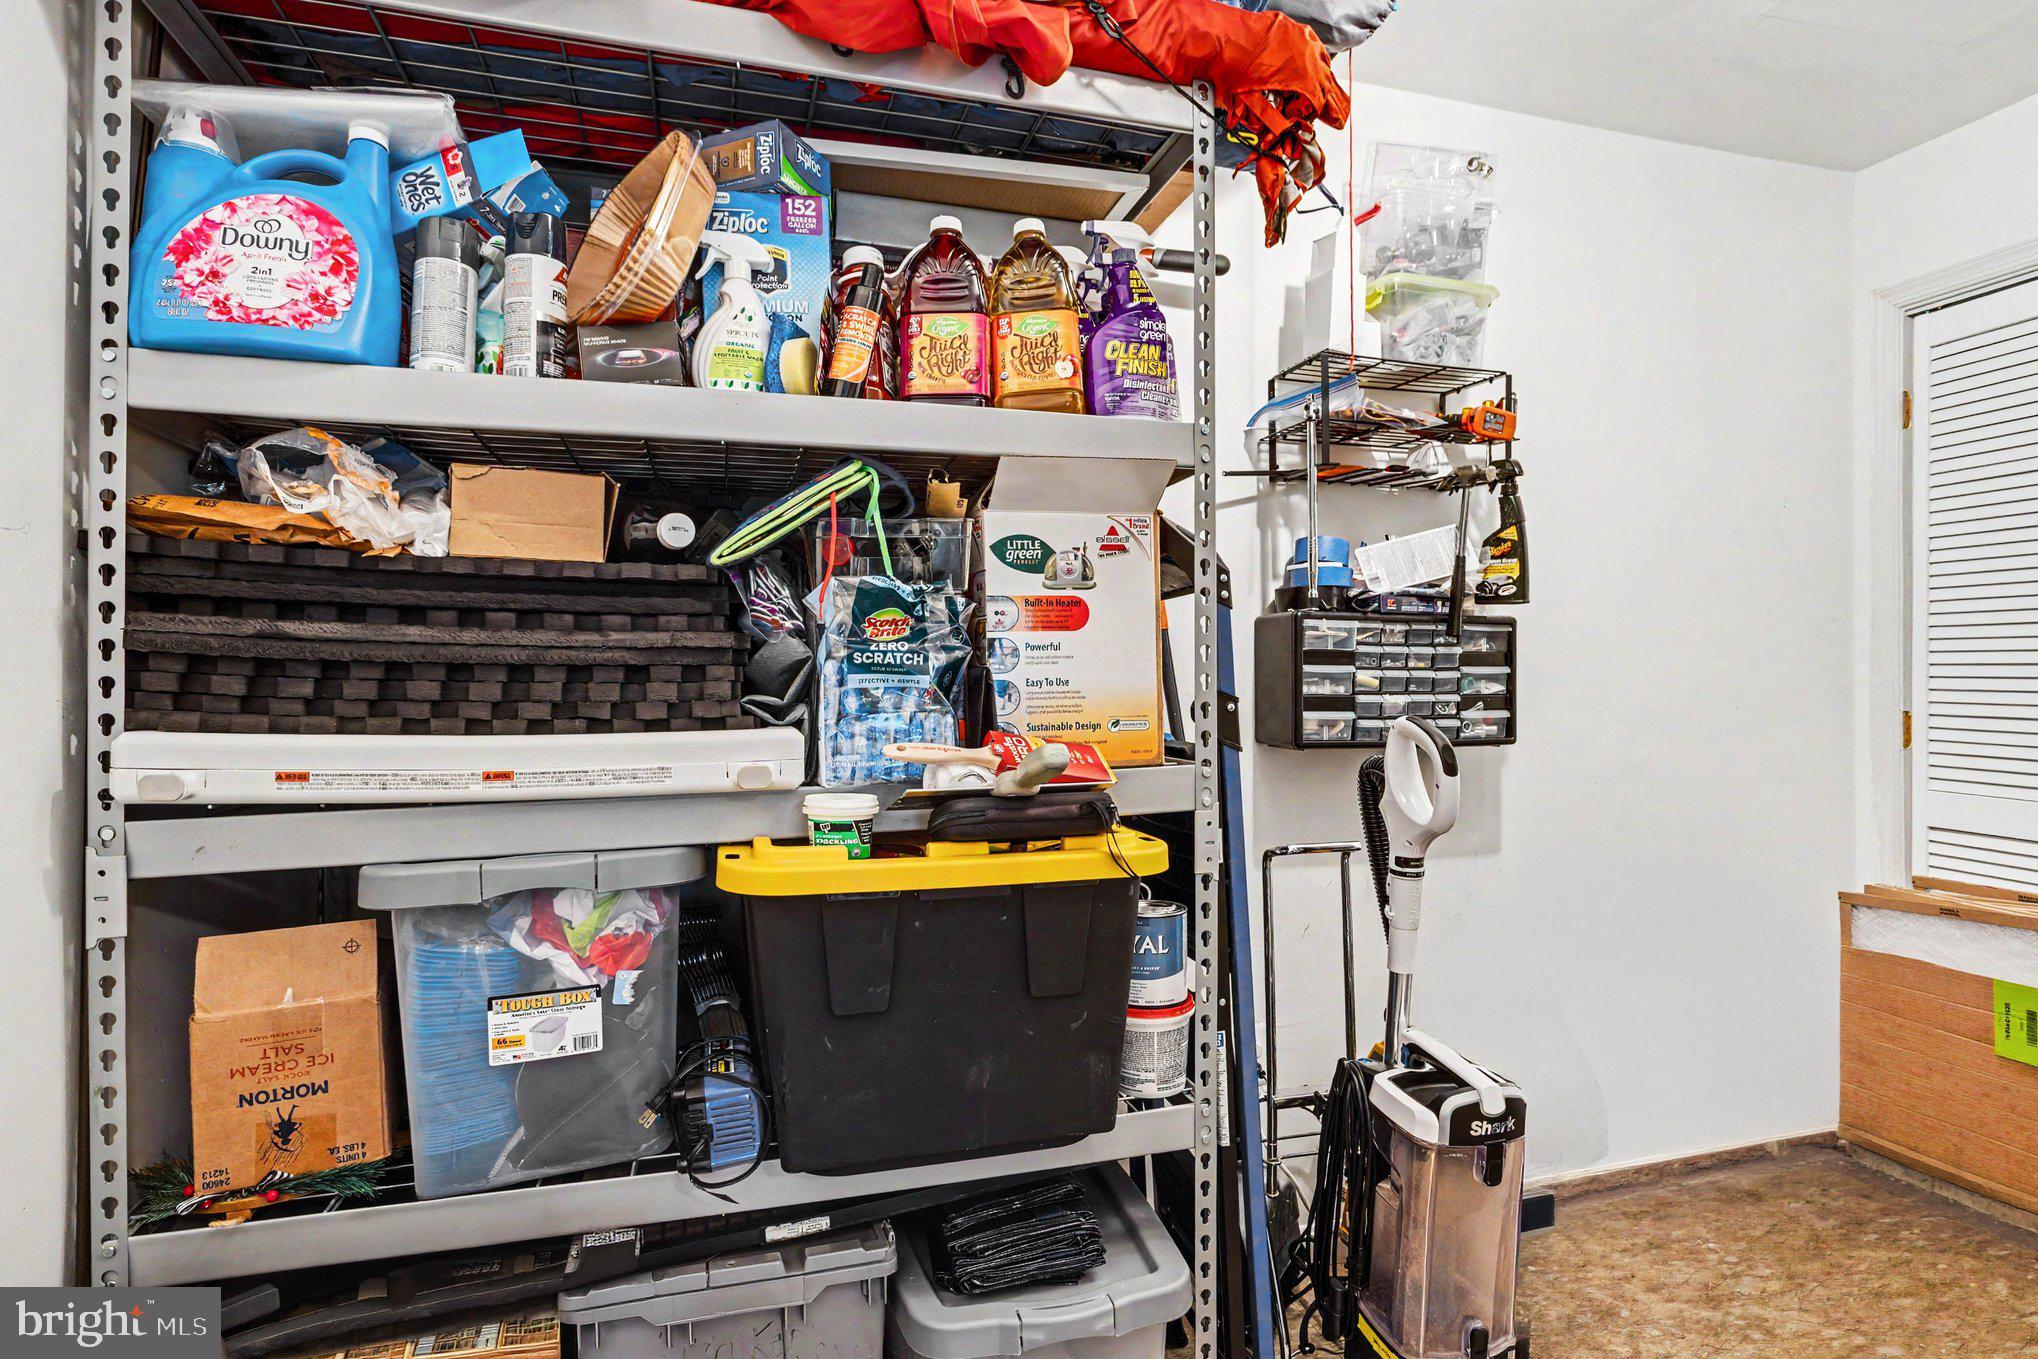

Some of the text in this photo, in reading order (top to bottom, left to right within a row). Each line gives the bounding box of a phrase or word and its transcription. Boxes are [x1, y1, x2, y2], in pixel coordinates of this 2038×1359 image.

[757, 133, 773, 175] Ziploc
[402, 171, 426, 212] Ones
[418, 165, 442, 207] Wet
[785, 198, 816, 216] 152
[712, 212, 769, 233] Ziploc
[221, 226, 310, 262] Downy
[241, 252, 262, 260] April
[250, 266, 272, 276] 2in1
[757, 274, 778, 282] Point
[752, 281, 789, 290] rotection
[1139, 317, 1166, 332] simple
[1139, 330, 1166, 342] green
[1105, 340, 1161, 362] CLEAN
[926, 349, 972, 377] Right
[1019, 345, 1064, 375] Right
[1115, 358, 1167, 378] FINISH
[1006, 540, 1041, 550] LITTLE
[1006, 549, 1043, 564] green
[1024, 598, 1082, 607] Built-In Heater
[869, 626, 907, 639] Brite
[869, 641, 909, 651] ZERO
[1025, 642, 1061, 651] Powerful
[853, 652, 924, 666] SCRATCH
[1025, 677, 1070, 687] Easy To Use
[1026, 721, 1102, 732] Sustainable Design
[1133, 934, 1170, 955] YAL
[498, 990, 593, 1014] TOUGH BOX
[496, 1037, 507, 1046] 66
[258, 1043, 304, 1060] SALT
[229, 1052, 334, 1080] ICE CREAM
[256, 1070, 310, 1084] ROCK SALT
[237, 1079, 329, 1108] MORTON
[1470, 1116, 1516, 1138] Shark
[361, 1141, 367, 1150] 4
[336, 1151, 367, 1164] 4 UNITS
[202, 1167, 231, 1180] 14213
